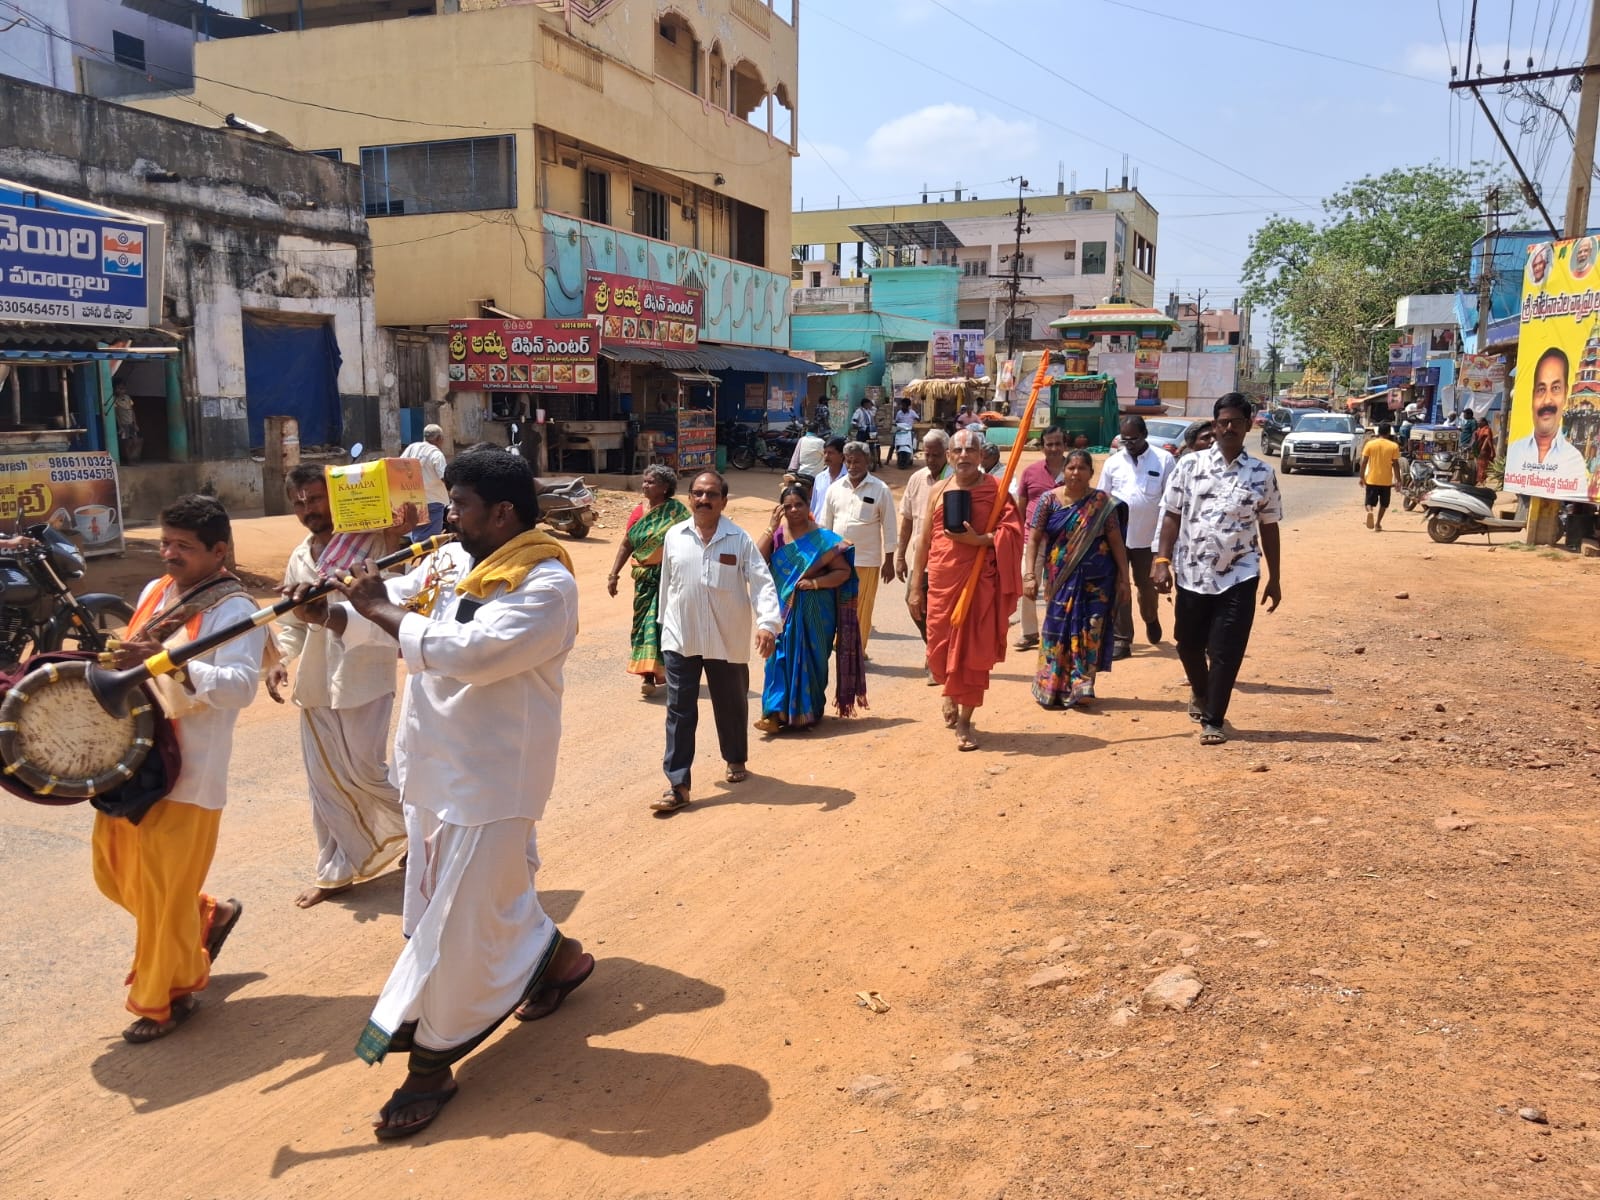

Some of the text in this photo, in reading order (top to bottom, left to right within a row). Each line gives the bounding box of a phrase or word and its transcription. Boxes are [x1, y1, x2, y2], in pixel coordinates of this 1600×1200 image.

[594, 281, 611, 312] శ్రీ
[613, 284, 642, 315] అమ్మ
[666, 298, 695, 316] సెంటర్
[449, 329, 591, 361] శ్రీ అమ్మ టిఫిన్ సెంటర్
[50, 468, 113, 482] 6305454575
